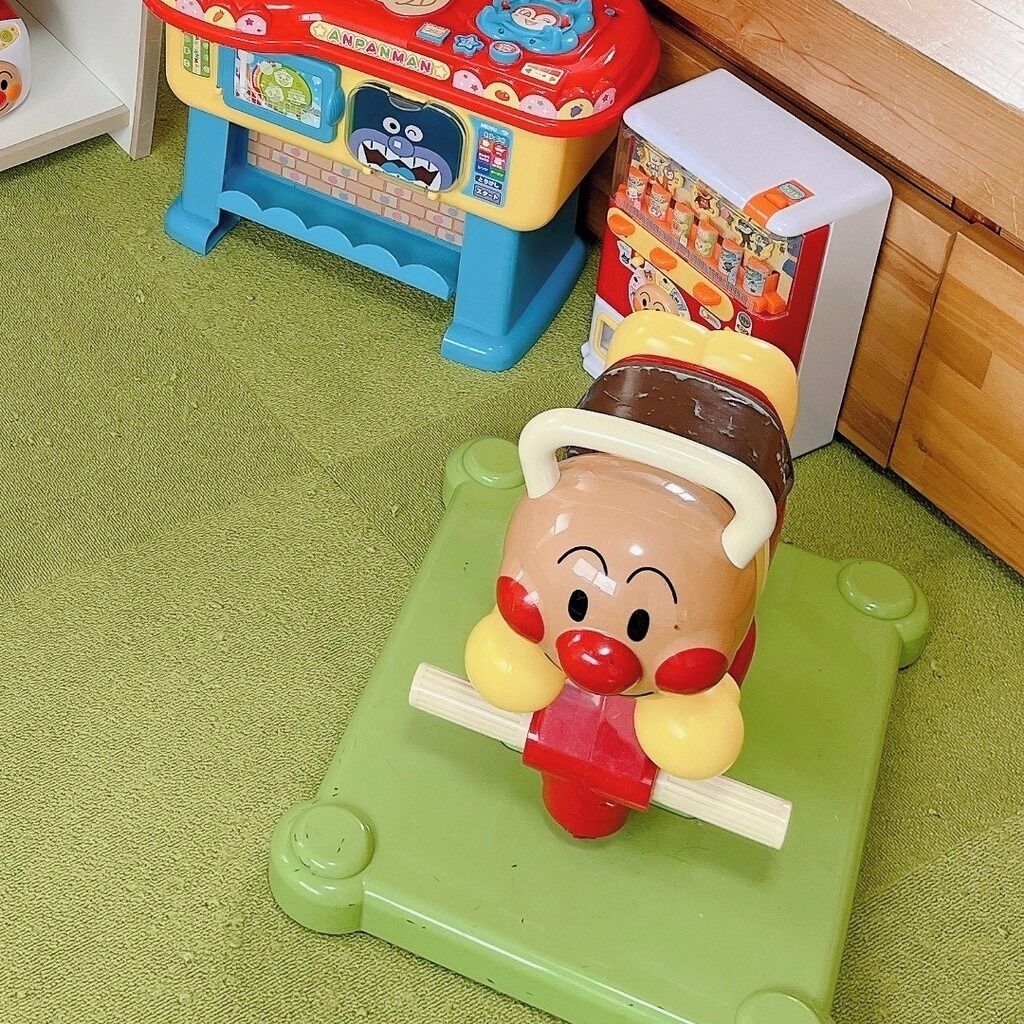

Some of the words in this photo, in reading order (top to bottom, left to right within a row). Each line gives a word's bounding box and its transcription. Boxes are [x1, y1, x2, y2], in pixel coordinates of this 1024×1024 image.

[327, 28, 433, 74] ANPANMAN
[478, 176, 499, 189] とりけし
[476, 187, 499, 201] スタート
